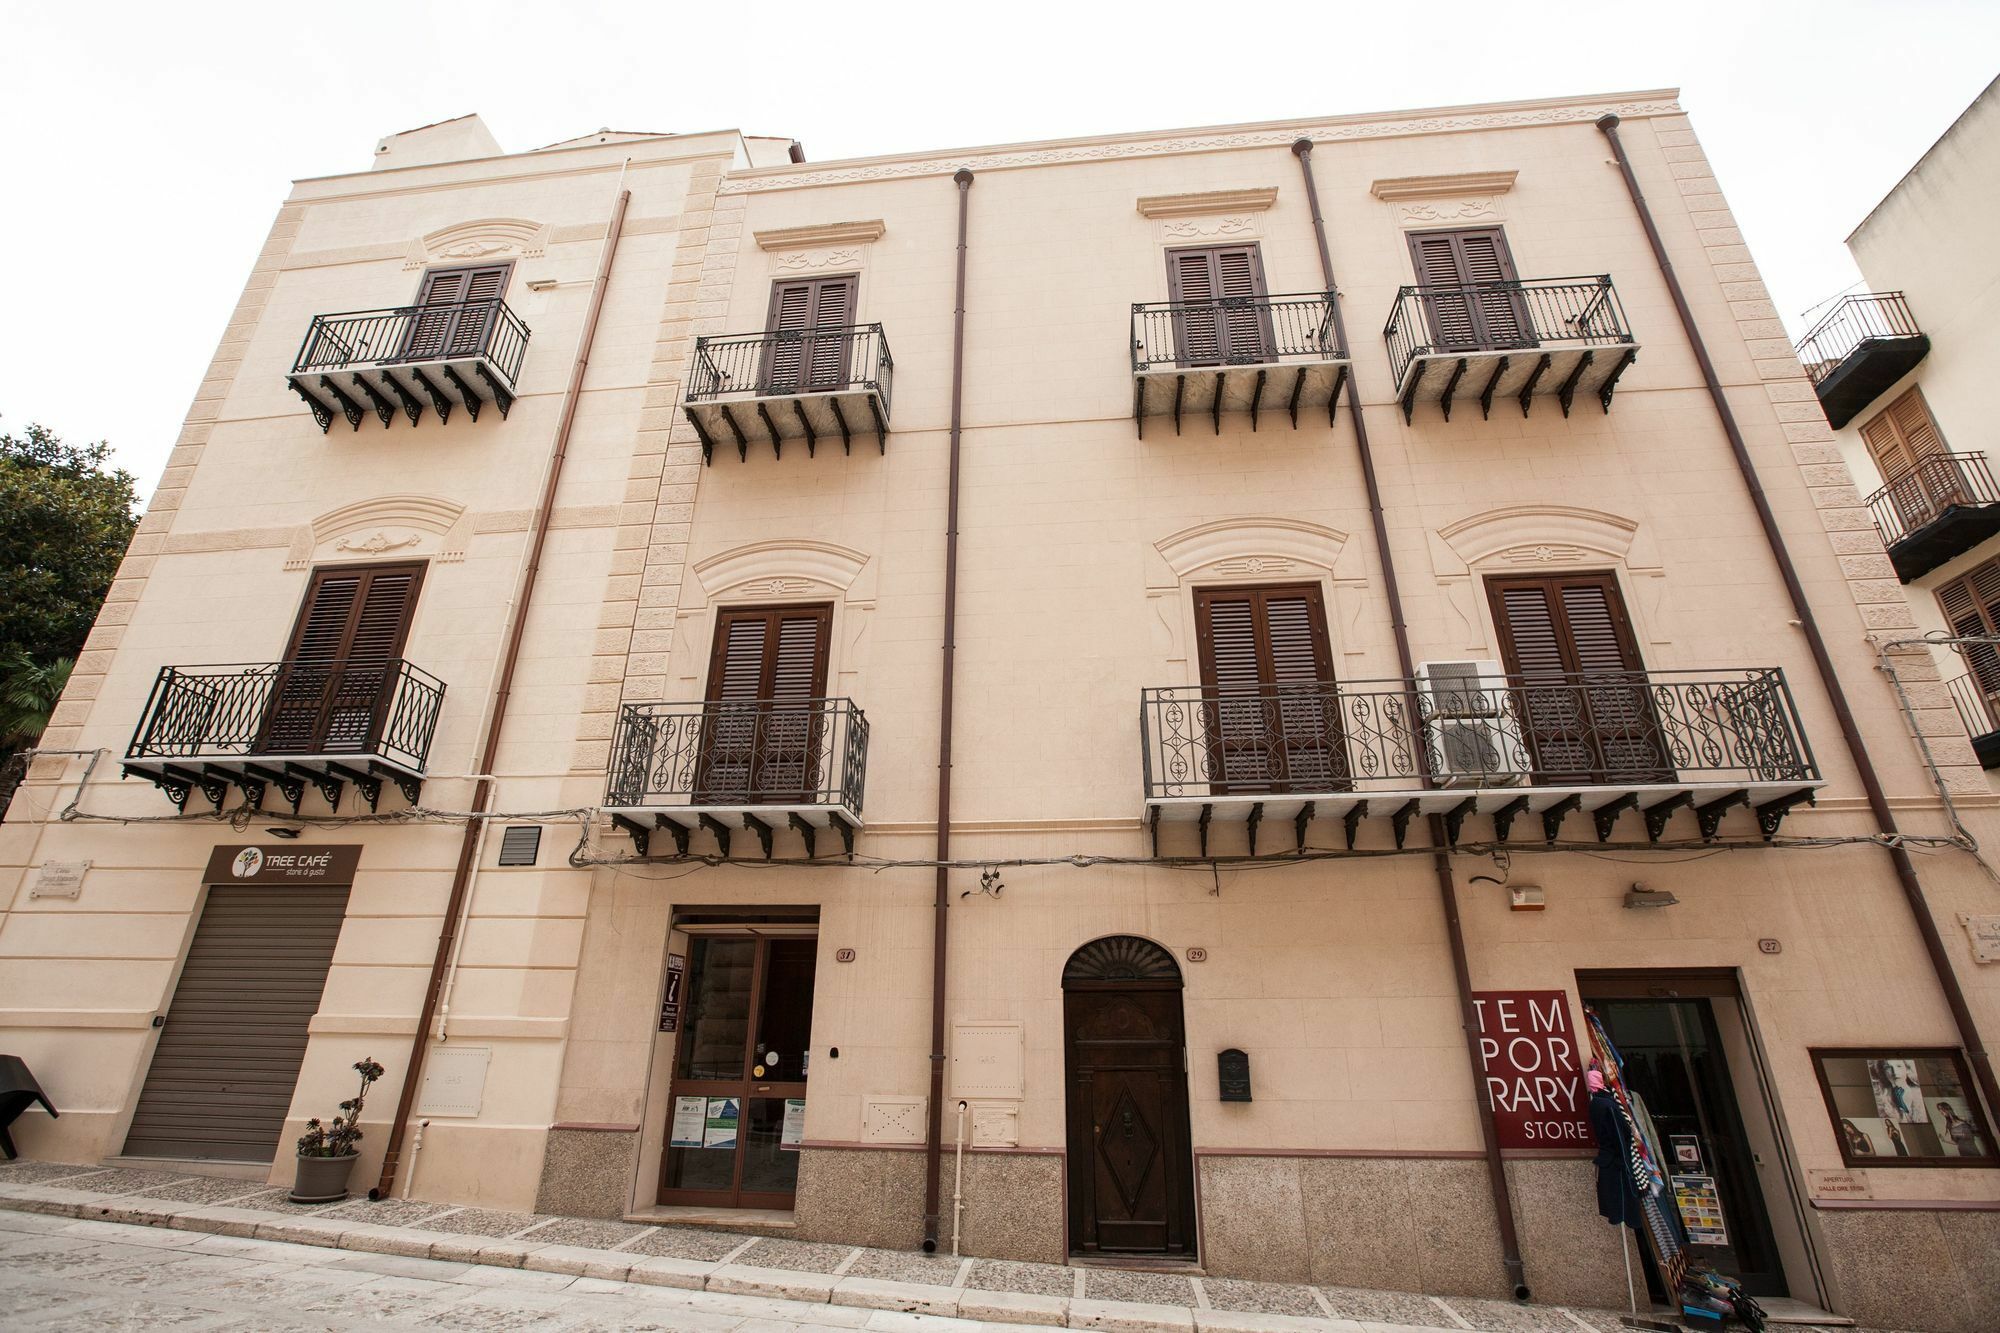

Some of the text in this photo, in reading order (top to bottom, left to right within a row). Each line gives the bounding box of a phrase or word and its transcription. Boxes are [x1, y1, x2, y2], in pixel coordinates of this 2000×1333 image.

[266, 851, 330, 867] TREE CAFÉ
[309, 868, 325, 877] gusto
[1764, 942, 1777, 951] 27
[840, 951, 851, 960] 31
[1191, 950, 1203, 960] 29
[1473, 999, 1566, 1033] TEM
[1479, 1037, 1574, 1073] POR
[1486, 1076, 1578, 1113] RARY
[1524, 1121, 1589, 1140] STORE
